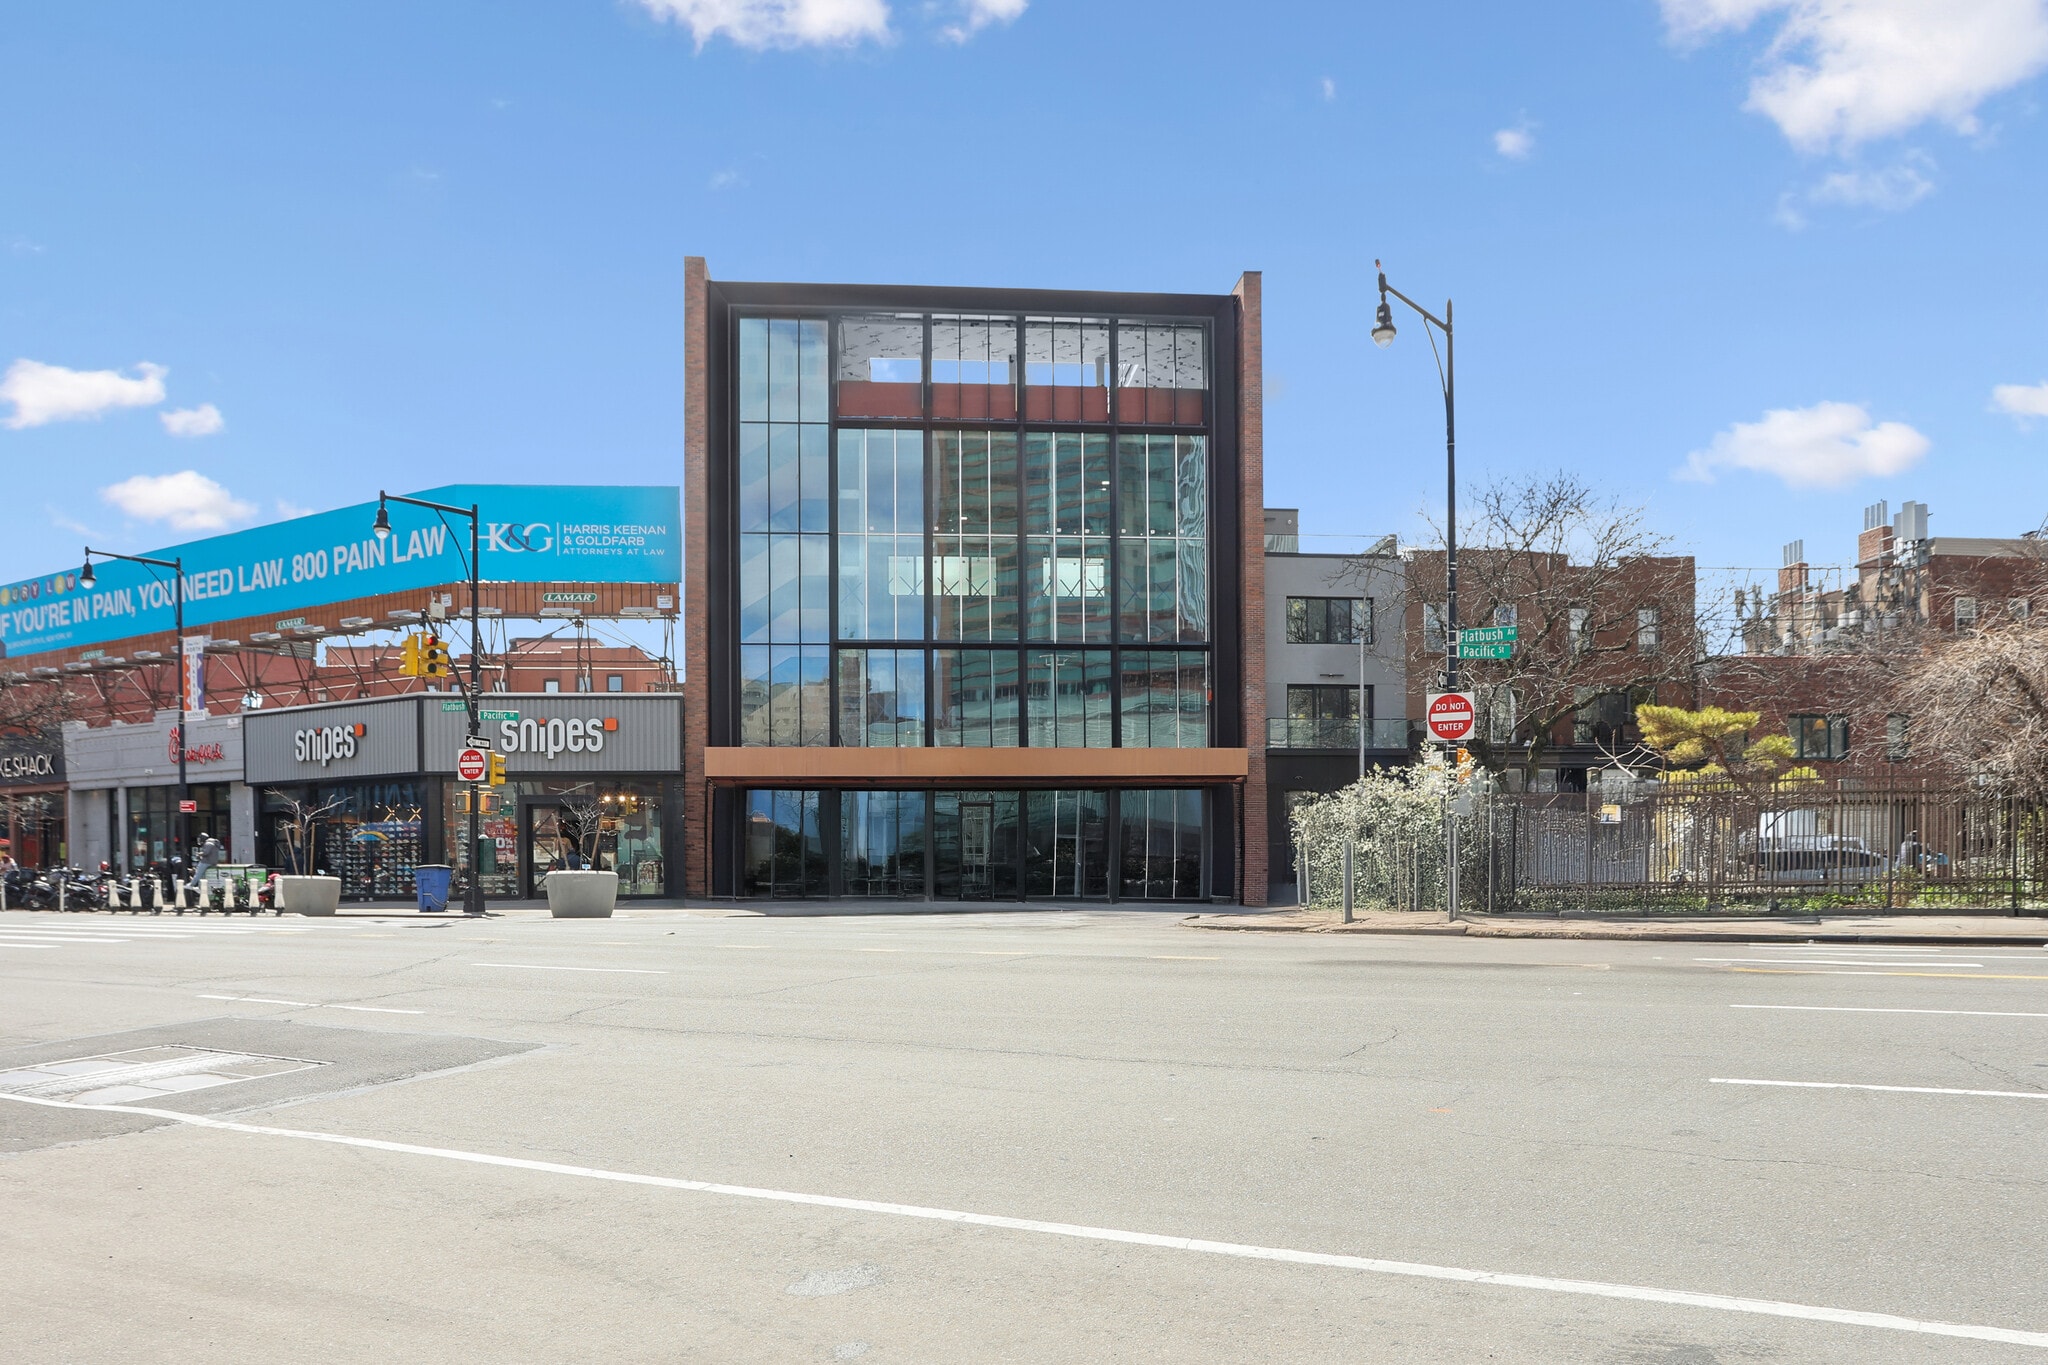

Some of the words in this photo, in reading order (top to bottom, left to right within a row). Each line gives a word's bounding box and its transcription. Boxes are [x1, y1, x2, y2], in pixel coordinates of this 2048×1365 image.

[563, 524, 610, 535] HARRIS
[613, 524, 666, 535] KEENAN
[563, 535, 572, 546] &
[575, 535, 645, 546] GOLDFARB
[562, 547, 623, 556] ATTORNEYS
[643, 548, 665, 556] LAW
[12, 600, 71, 635] YOU'RE
[73, 596, 89, 623] IN
[93, 588, 136, 620] PAIN,
[138, 578, 177, 610] YOU
[181, 568, 233, 603] NEED
[238, 558, 287, 593] LAW.
[292, 550, 328, 583] 800
[333, 538, 385, 575] PAIN
[392, 524, 446, 563] LAW
[547, 593, 592, 601] LAMAR
[1460, 629, 1504, 642] Flatbush
[1507, 628, 1515, 636] Av
[1463, 646, 1496, 657] Pacific
[442, 702, 465, 711] Flatbush
[1436, 703, 1447, 711] DO
[1450, 702, 1465, 710] NOT
[483, 711, 507, 720] Pacific
[1438, 723, 1464, 731] ENTER
[501, 719, 604, 759] snipes
[295, 725, 356, 767] snipes
[13, 754, 55, 777] SHACK
